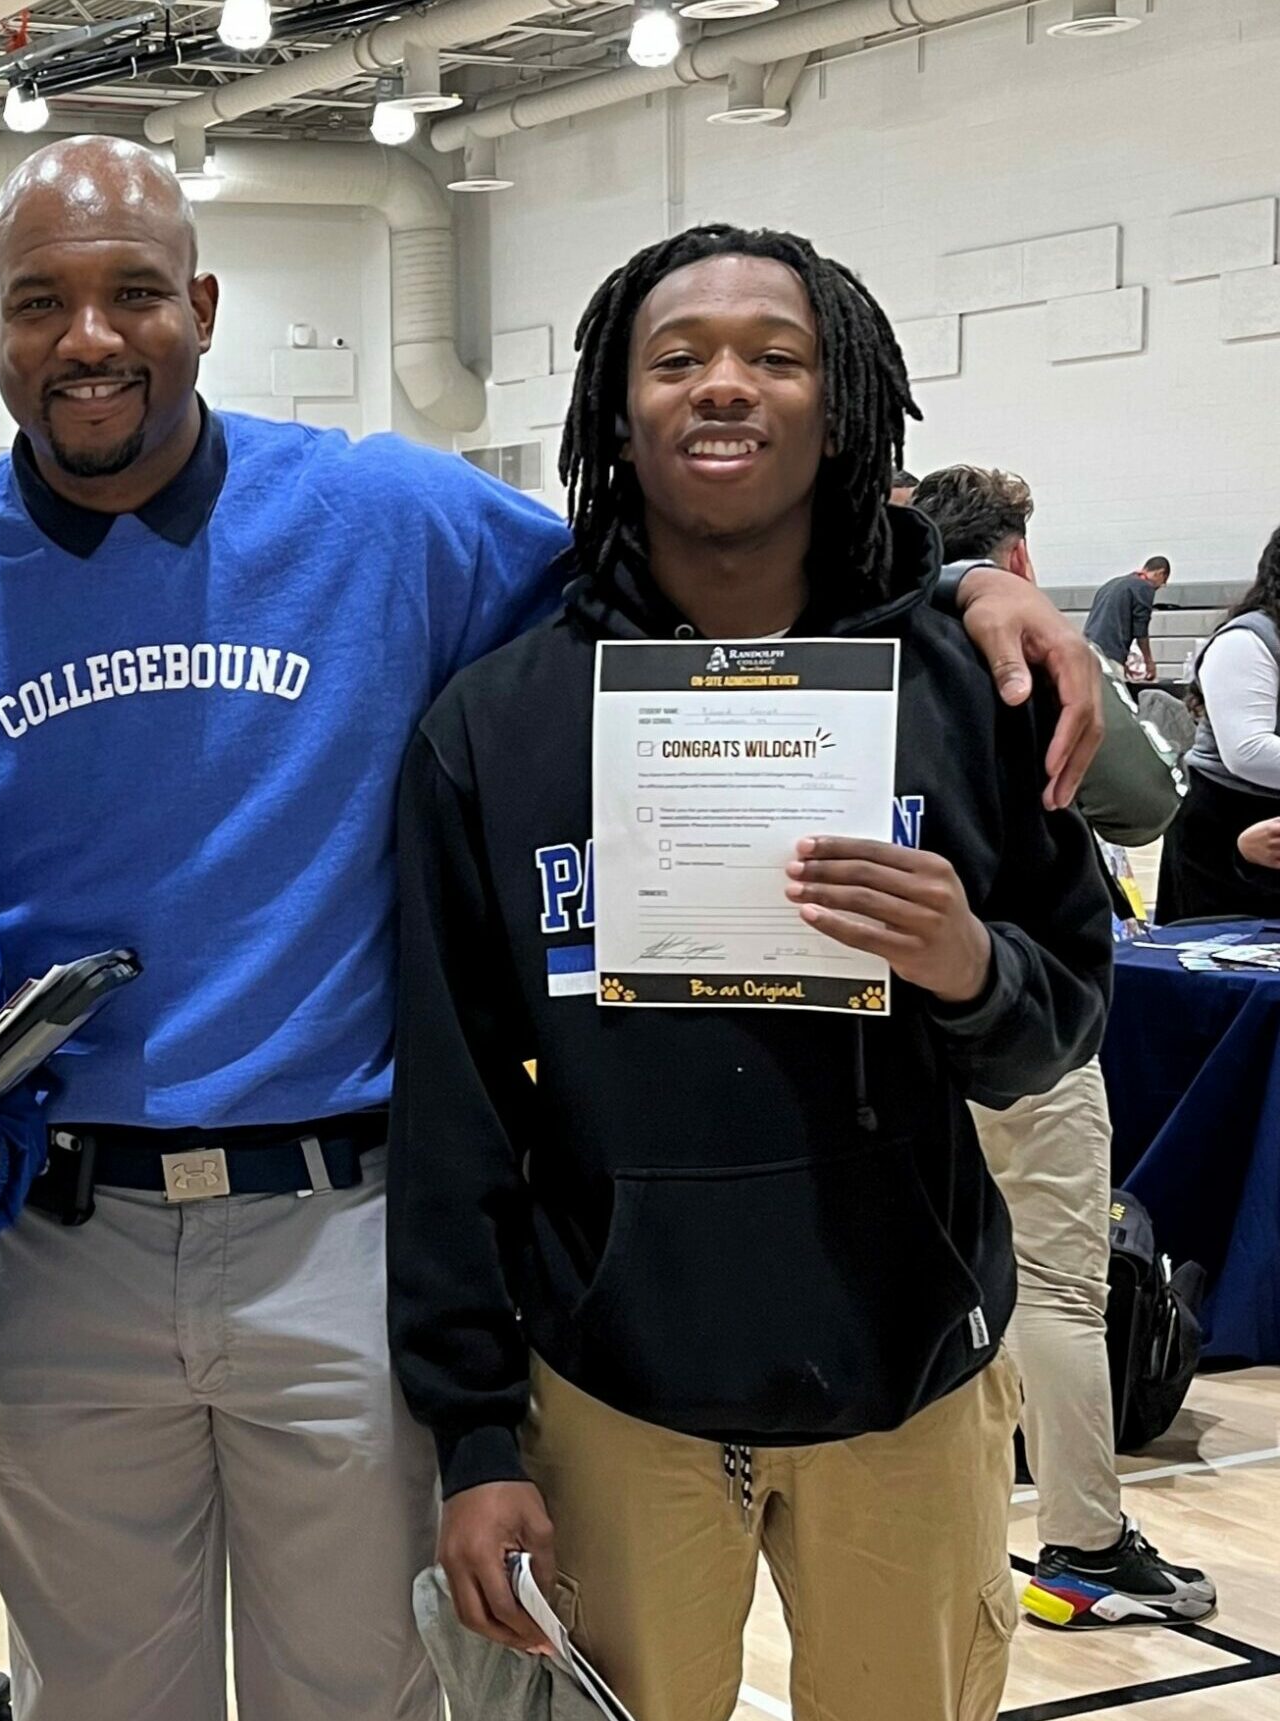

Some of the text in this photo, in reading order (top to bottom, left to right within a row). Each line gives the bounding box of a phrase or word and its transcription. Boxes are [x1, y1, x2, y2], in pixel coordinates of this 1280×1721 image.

[729, 649, 784, 659] RANDOLPH
[661, 740, 816, 758] CONGRATS WILDCAT!
[690, 979, 806, 1002] Be an Original
